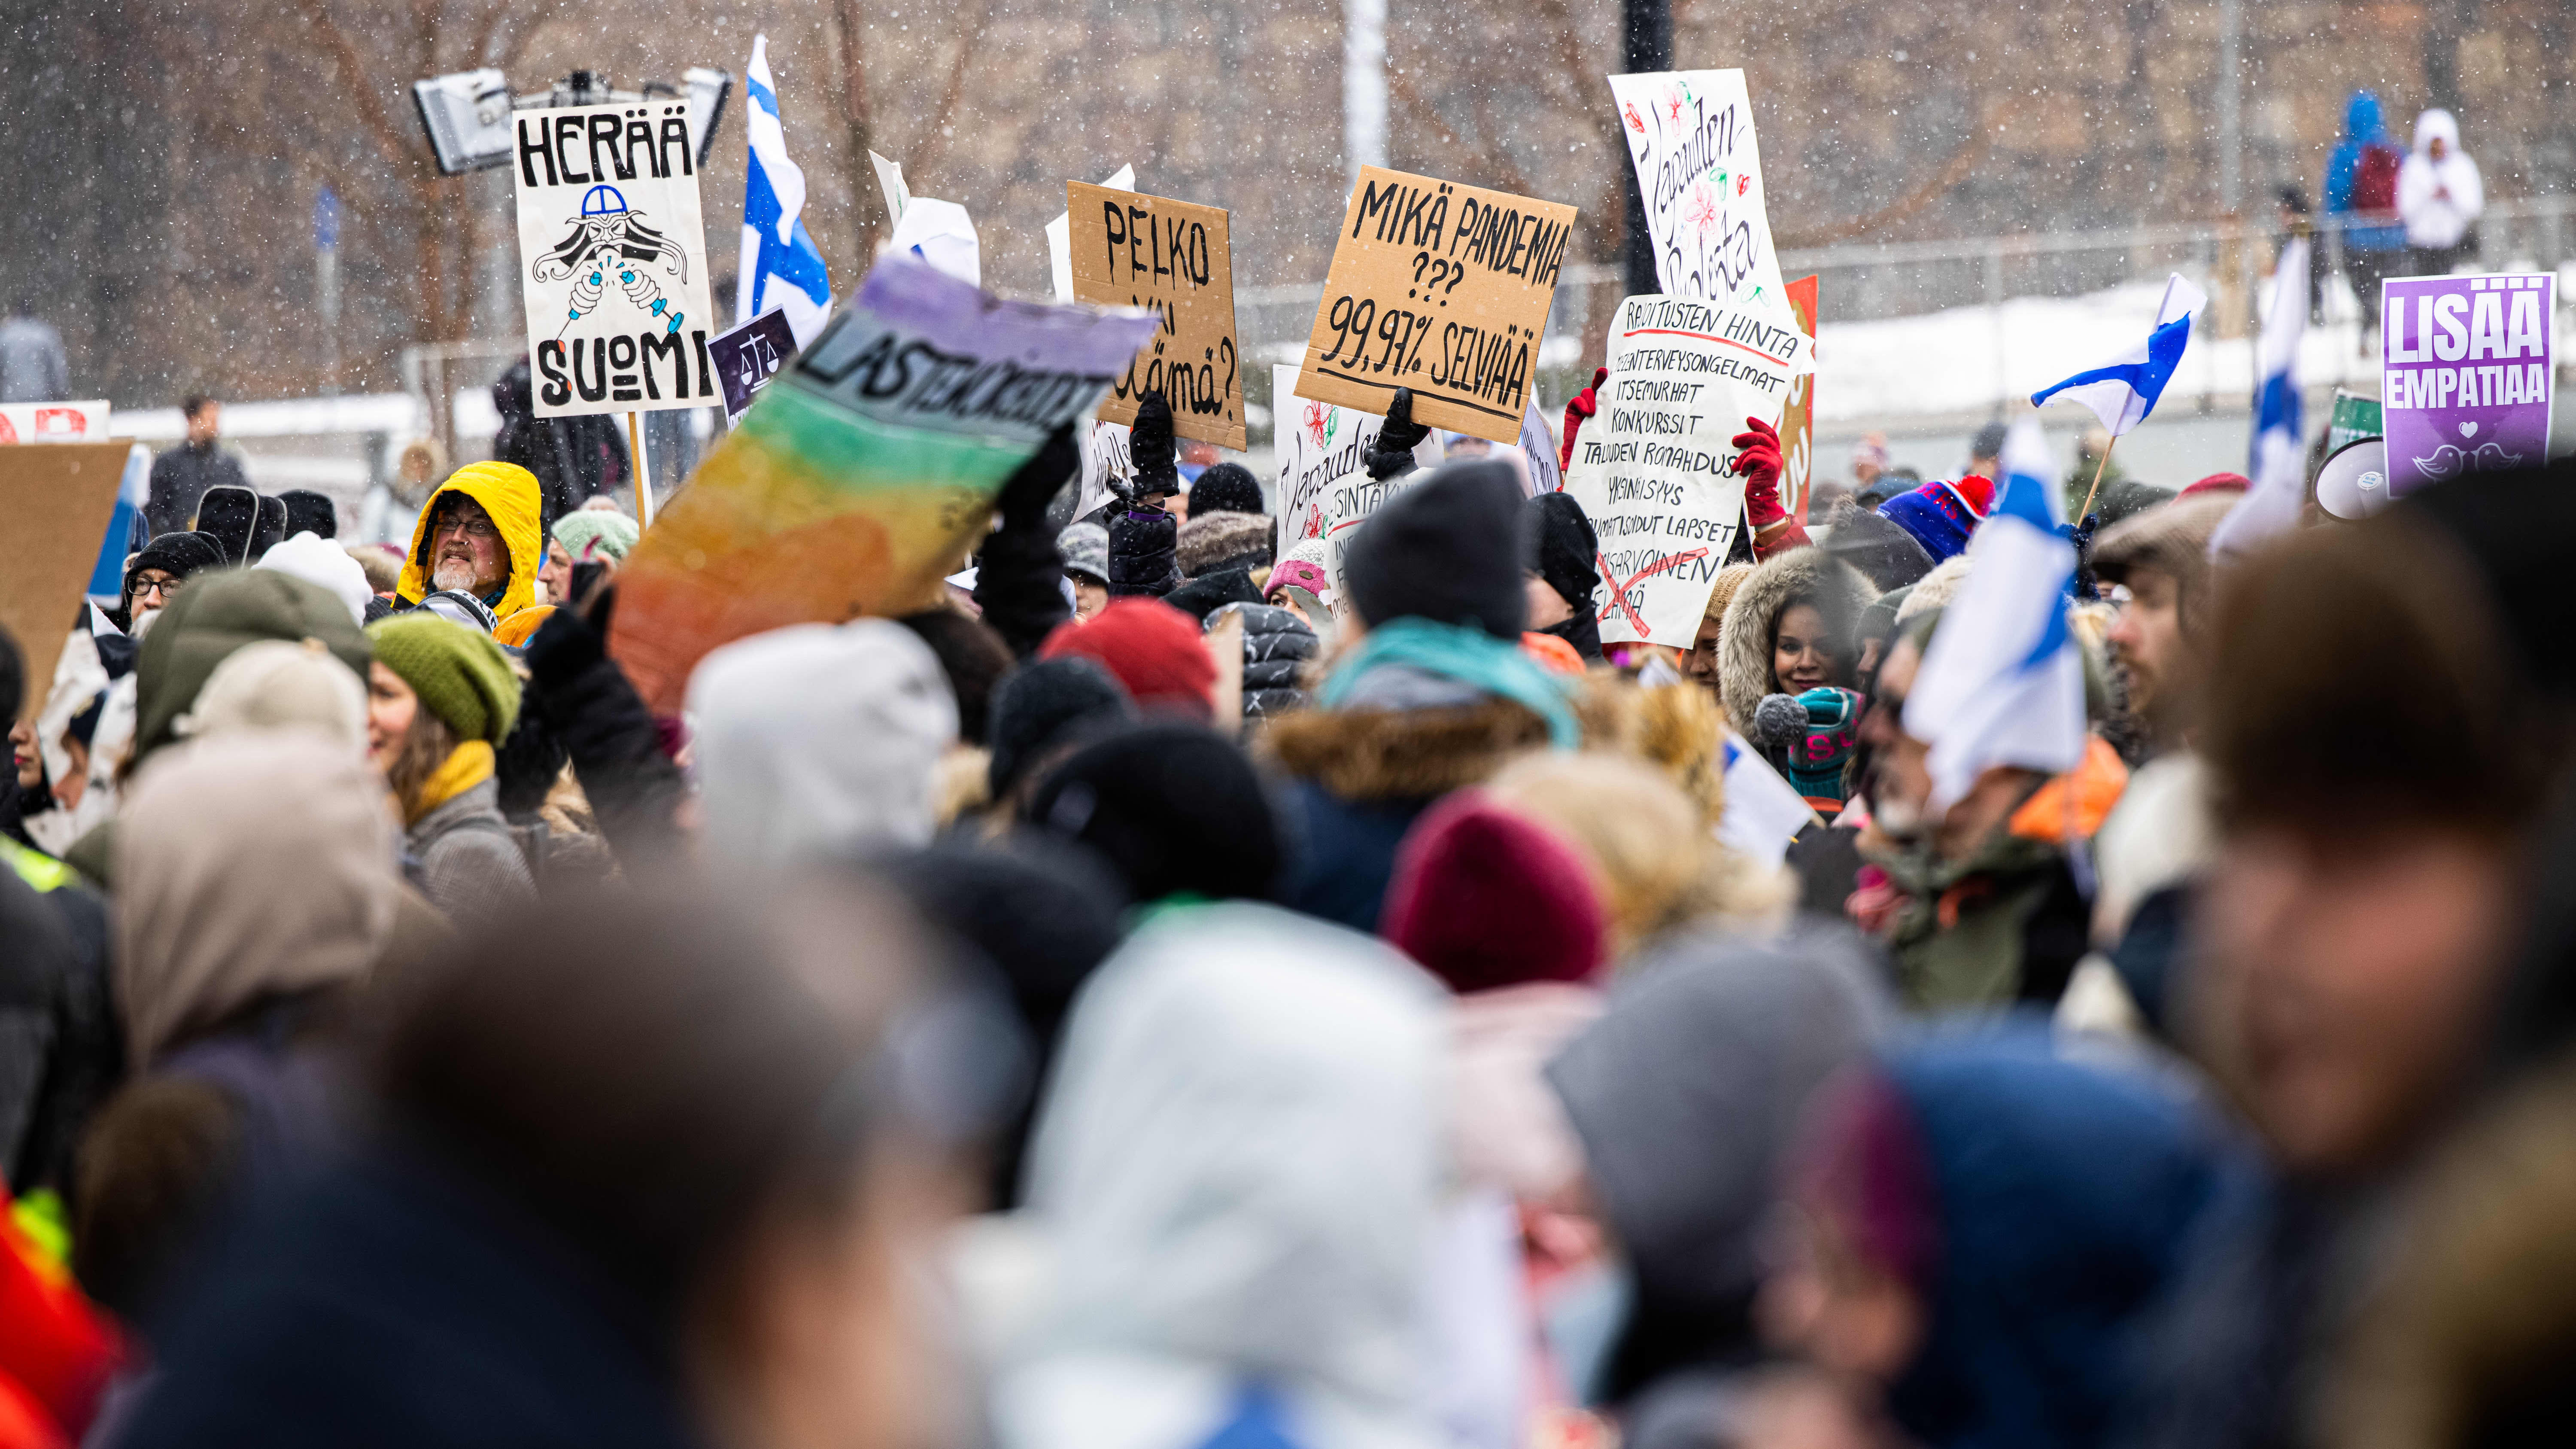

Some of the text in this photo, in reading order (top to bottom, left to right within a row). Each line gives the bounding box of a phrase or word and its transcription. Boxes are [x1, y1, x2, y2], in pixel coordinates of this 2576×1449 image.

[518, 106, 693, 187] HERÄÄ
[1640, 96, 1746, 248] Vapauden
[1104, 201, 1209, 291] PELKO
[1352, 180, 1570, 289] MIKÄ PANDEMIA
[1409, 251, 1464, 307] ???
[1724, 313, 1798, 358] HINTA
[2388, 277, 2544, 364] LISÄÄ
[538, 330, 714, 406] SUOMI
[1321, 295, 1534, 410] 99,97% SELVIÄÄ
[1616, 380, 1704, 403] ITSEMURHAT
[2386, 363, 2546, 409] EMPATIAA
[1611, 408, 1704, 435] KONKURSSIT
[1281, 417, 1380, 543] Vapaude
[1584, 441, 1638, 465] TALOUDEN
[1643, 442, 1738, 478] ROMAHDUS
[1609, 476, 1683, 506] YKSINÄISYYS
[1666, 515, 1736, 543] LAPSET
[1596, 548, 1720, 584] MISARVOINEN
